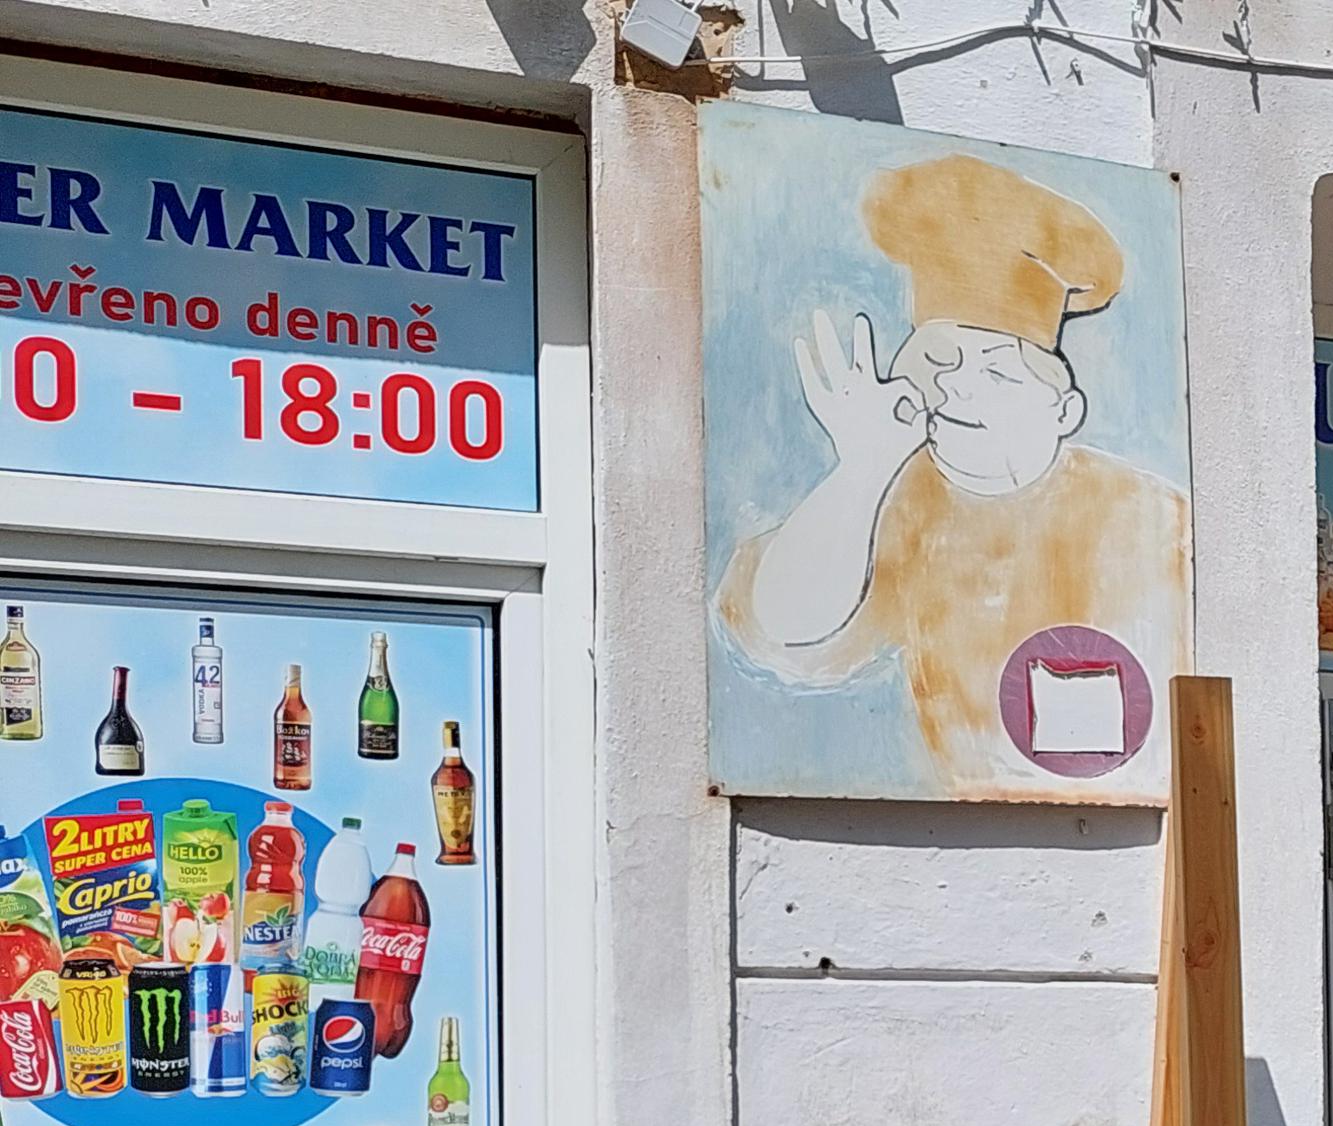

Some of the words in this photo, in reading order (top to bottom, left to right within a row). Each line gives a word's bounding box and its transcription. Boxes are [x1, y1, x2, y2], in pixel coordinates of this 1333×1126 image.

[147, 180, 516, 282] MARKET
[247, 292, 438, 352] denně
[14, 337, 76, 421] 0
[232, 359, 502, 460] 18:00
[195, 665, 220, 687] 42
[54, 850, 107, 873] SUPER
[111, 842, 152, 860] CENA
[170, 846, 218, 860] HELLO
[179, 866, 207, 875] 100%
[179, 876, 208, 884] apple
[57, 873, 154, 915] Caprio
[321, 1058, 363, 1069] pepsi
